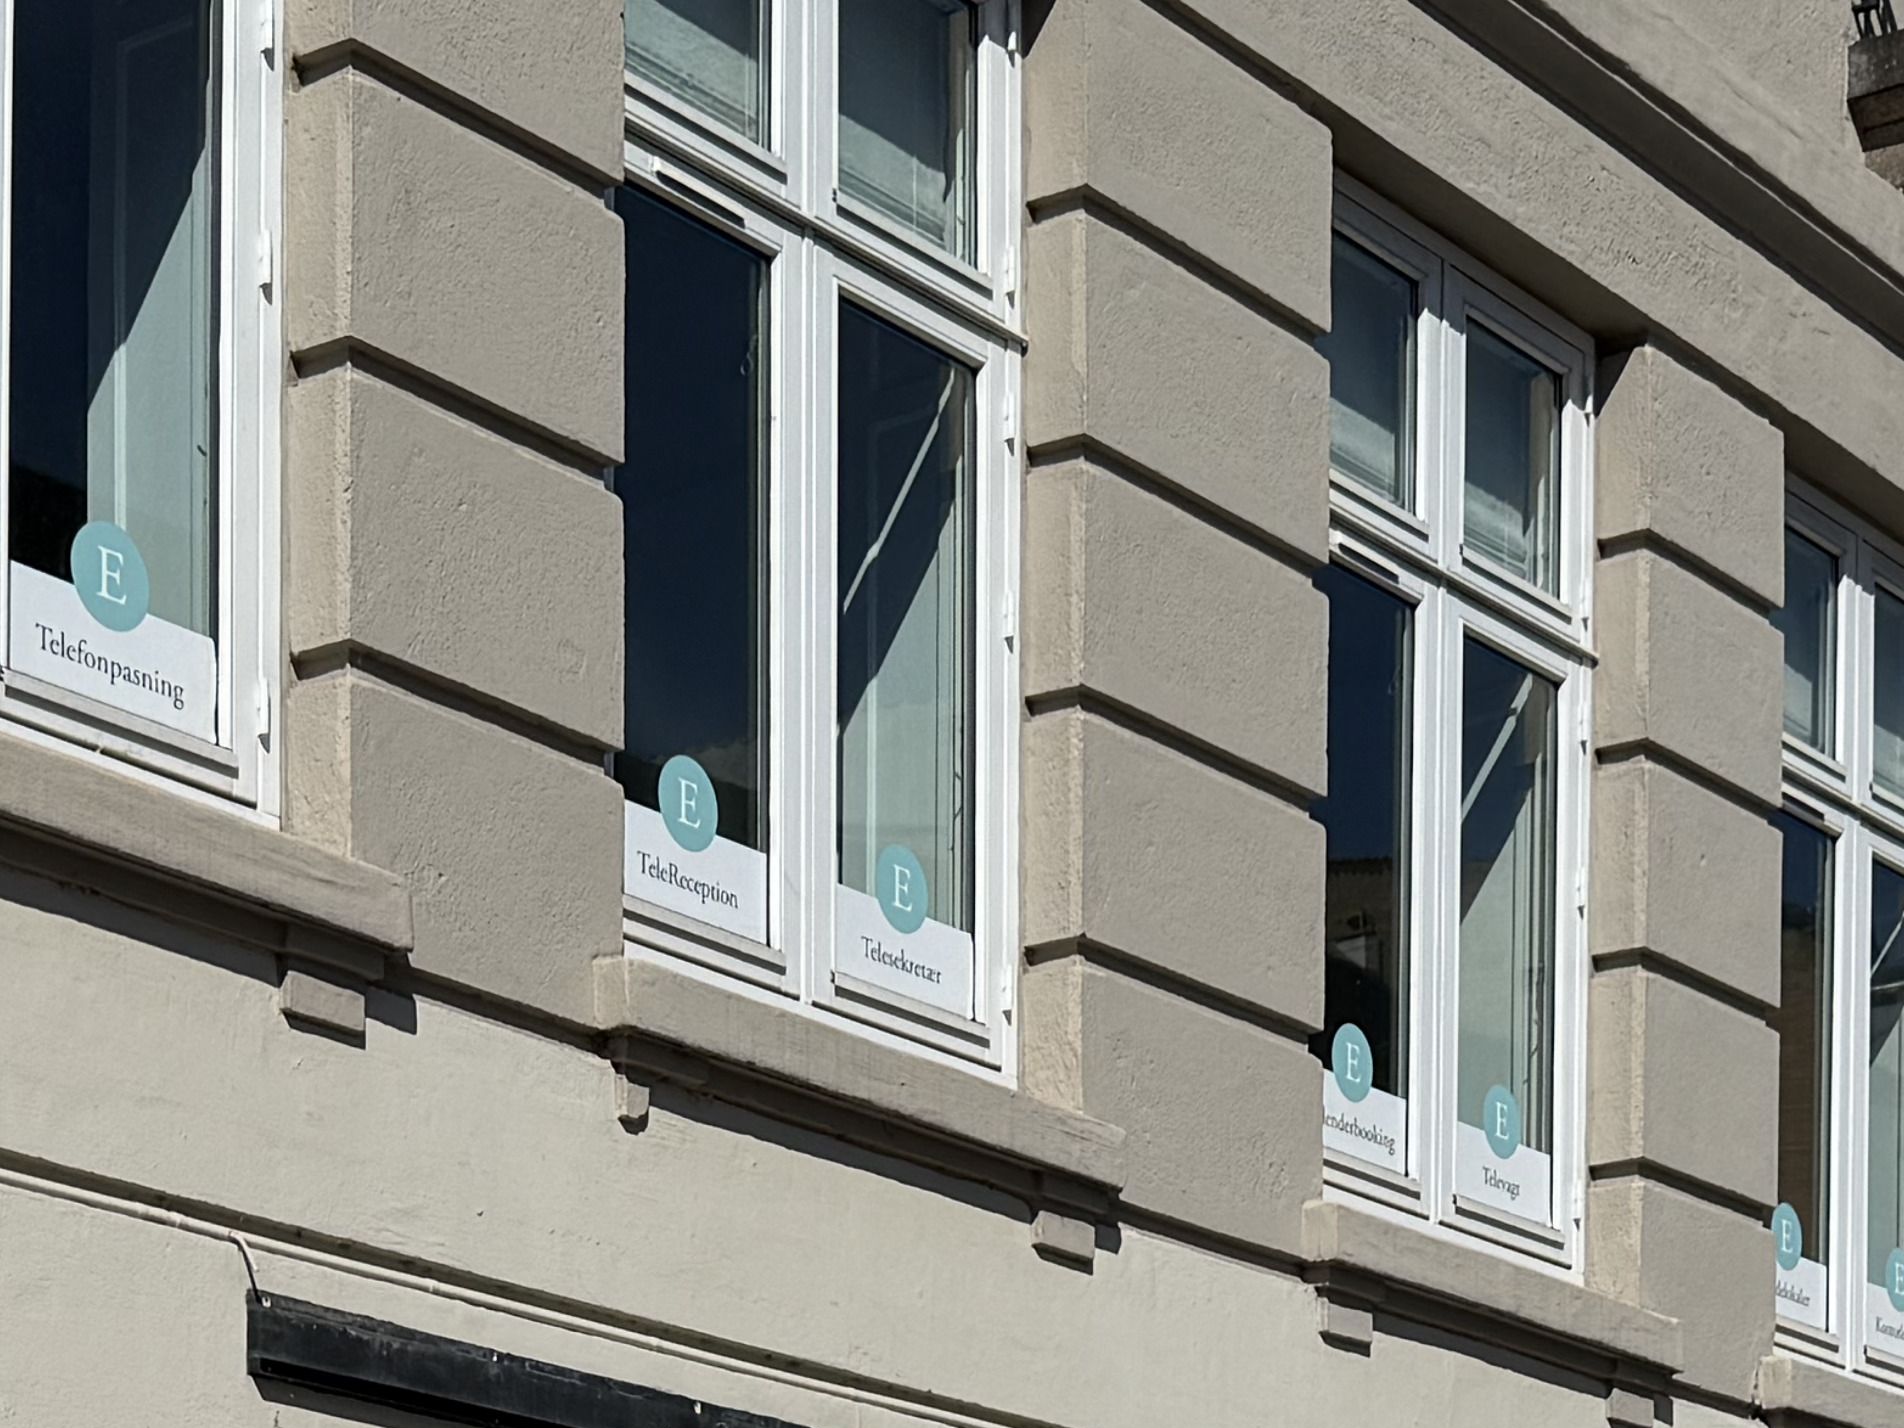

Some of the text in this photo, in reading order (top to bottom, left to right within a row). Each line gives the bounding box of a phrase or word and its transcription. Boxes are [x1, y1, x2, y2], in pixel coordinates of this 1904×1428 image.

[96, 545, 127, 606] E
[35, 622, 185, 710] Telefonpasning
[677, 776, 701, 829] E
[636, 850, 739, 909] TeleReception
[891, 864, 913, 912] E
[1345, 1042, 1361, 1083] E
[1324, 1112, 1396, 1156] enderbooking
[1495, 1101, 1509, 1140] E
[1781, 1219, 1794, 1254] E
